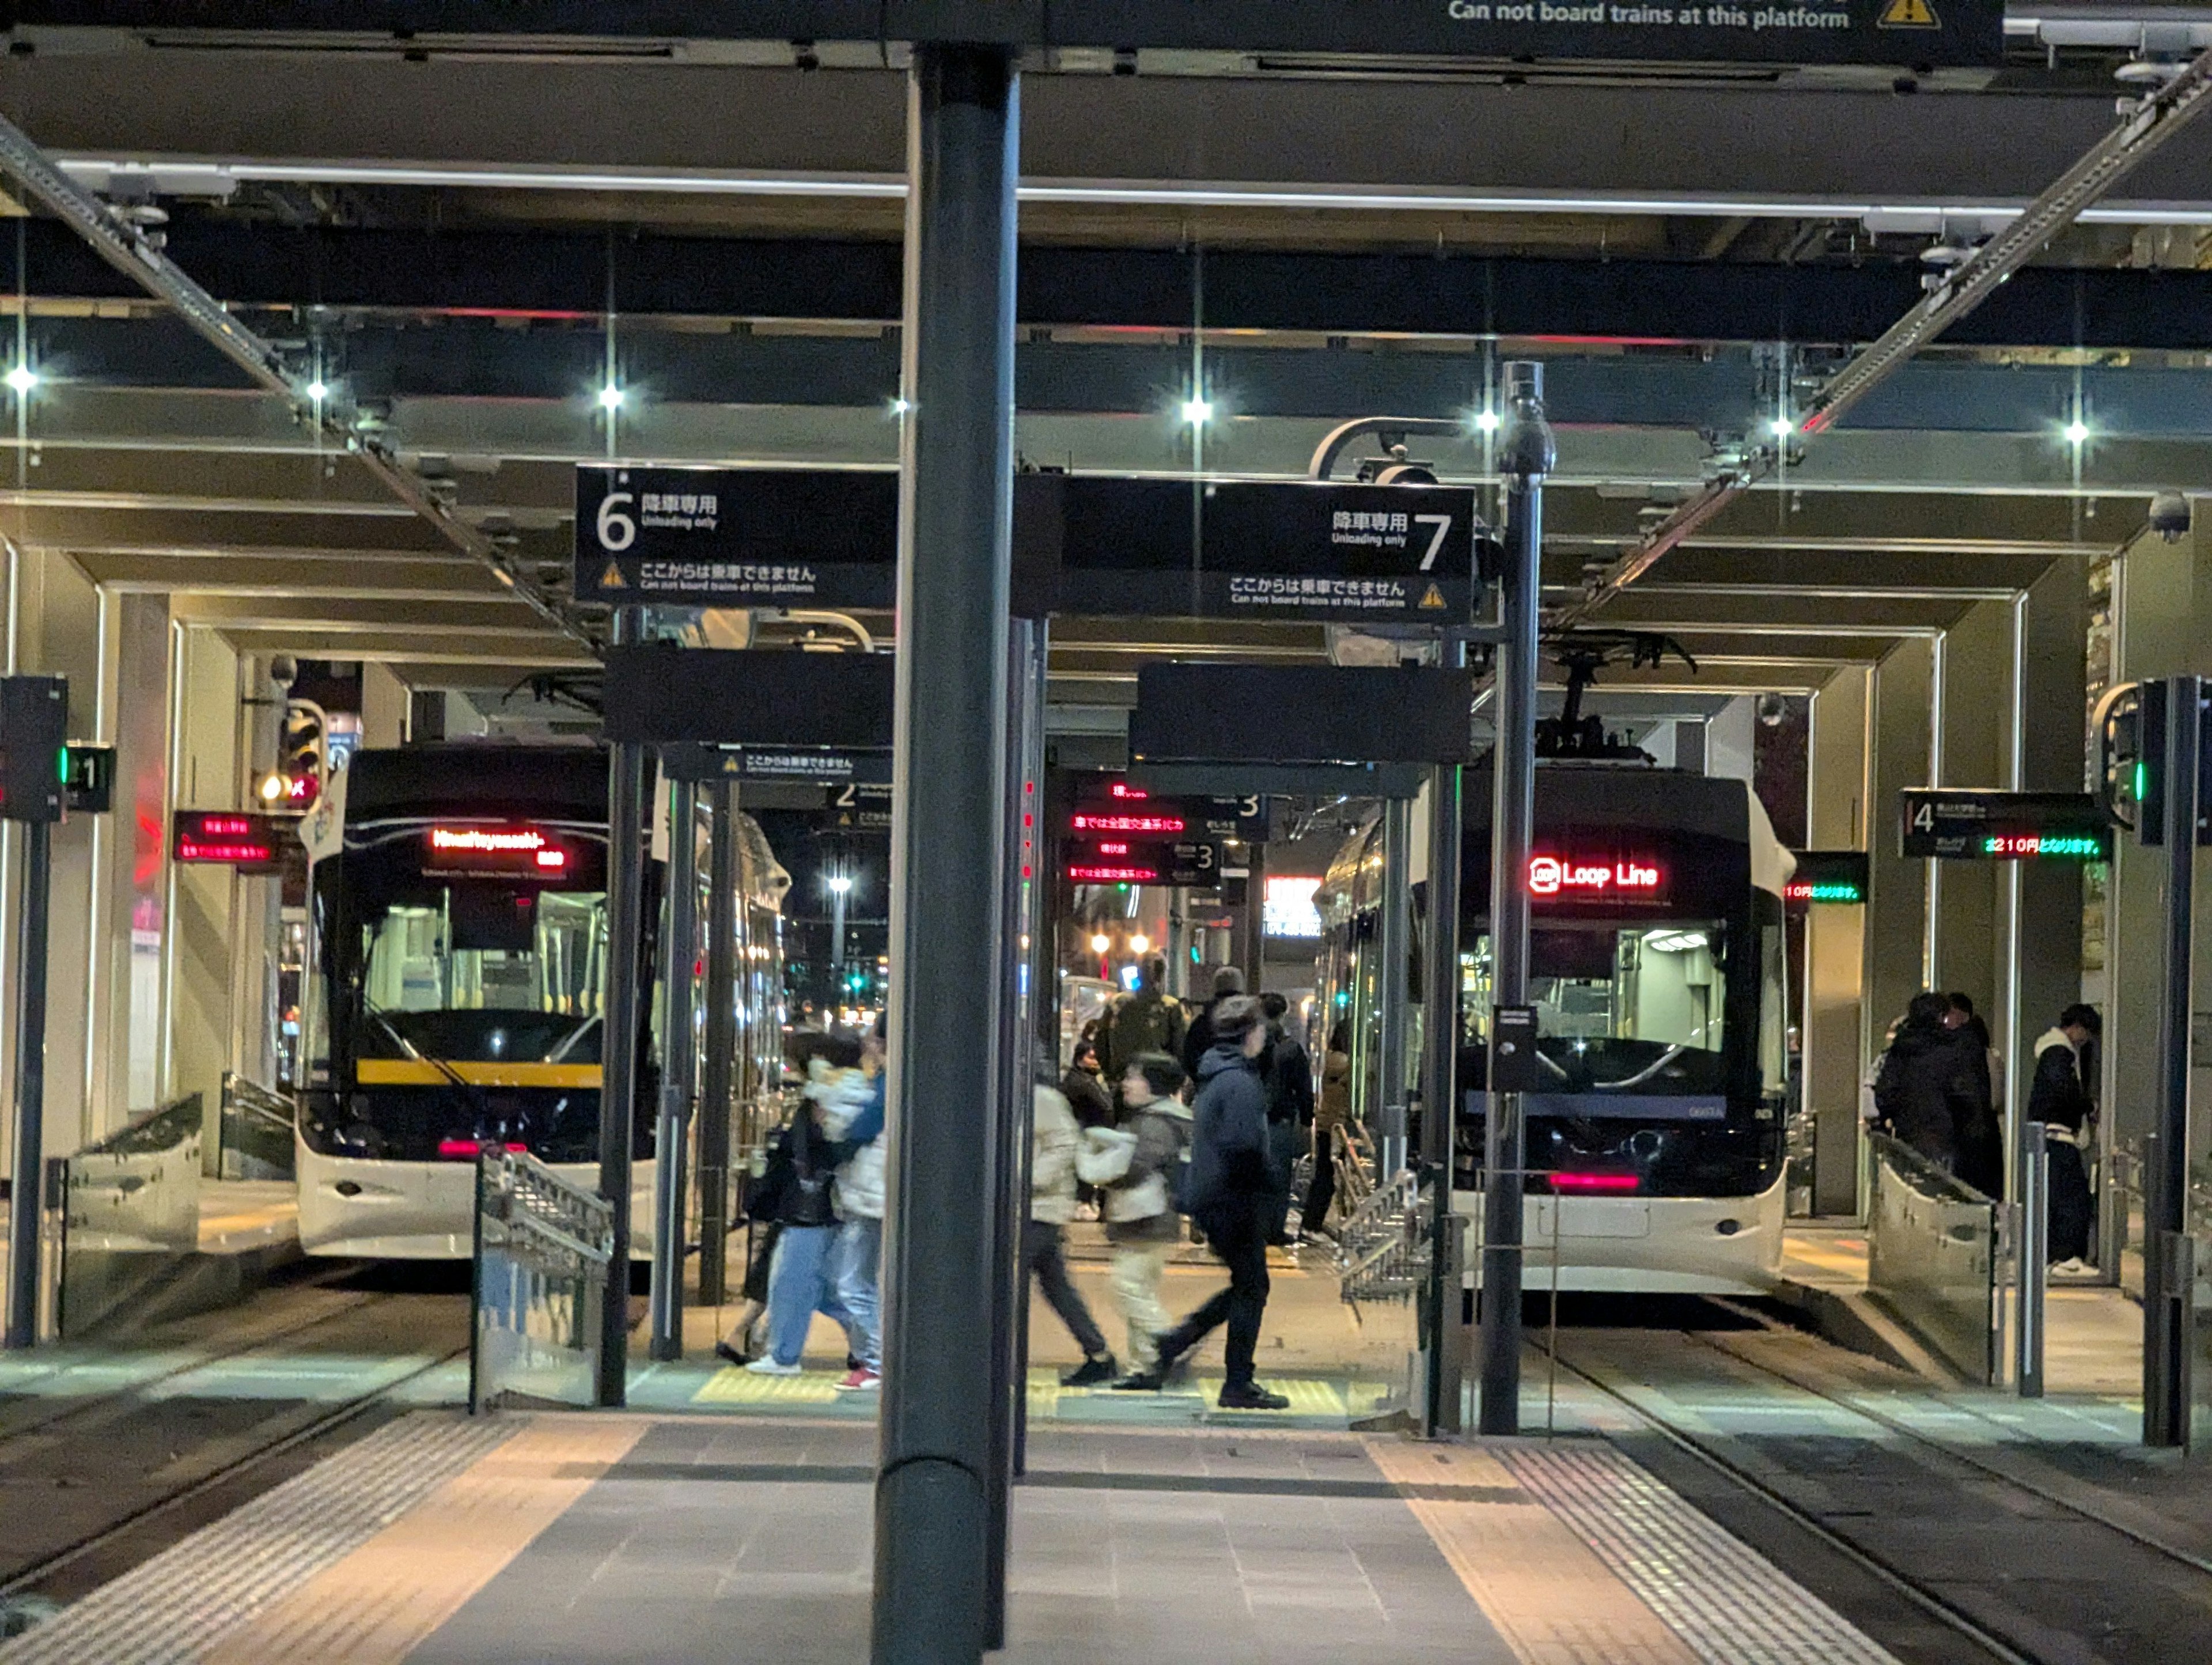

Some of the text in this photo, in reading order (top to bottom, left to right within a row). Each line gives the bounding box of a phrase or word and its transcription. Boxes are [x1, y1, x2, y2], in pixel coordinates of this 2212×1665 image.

[1448, 1, 1849, 31] Can not board trains at this platform
[642, 493, 717, 515] 降車専用
[597, 493, 636, 551] 6
[1333, 511, 1407, 532] 降車専用
[1332, 532, 1407, 548] Unloading only
[1415, 514, 1451, 570] 7
[641, 563, 816, 582] ここからは乗車できません
[1230, 577, 1405, 597] ここからは乗車できません
[1232, 594, 1250, 603] Can
[1239, 794, 1259, 817] 3
[1914, 802, 1934, 833] 4
[1198, 845, 1213, 869] 3
[1563, 863, 1657, 888] Loop Line
